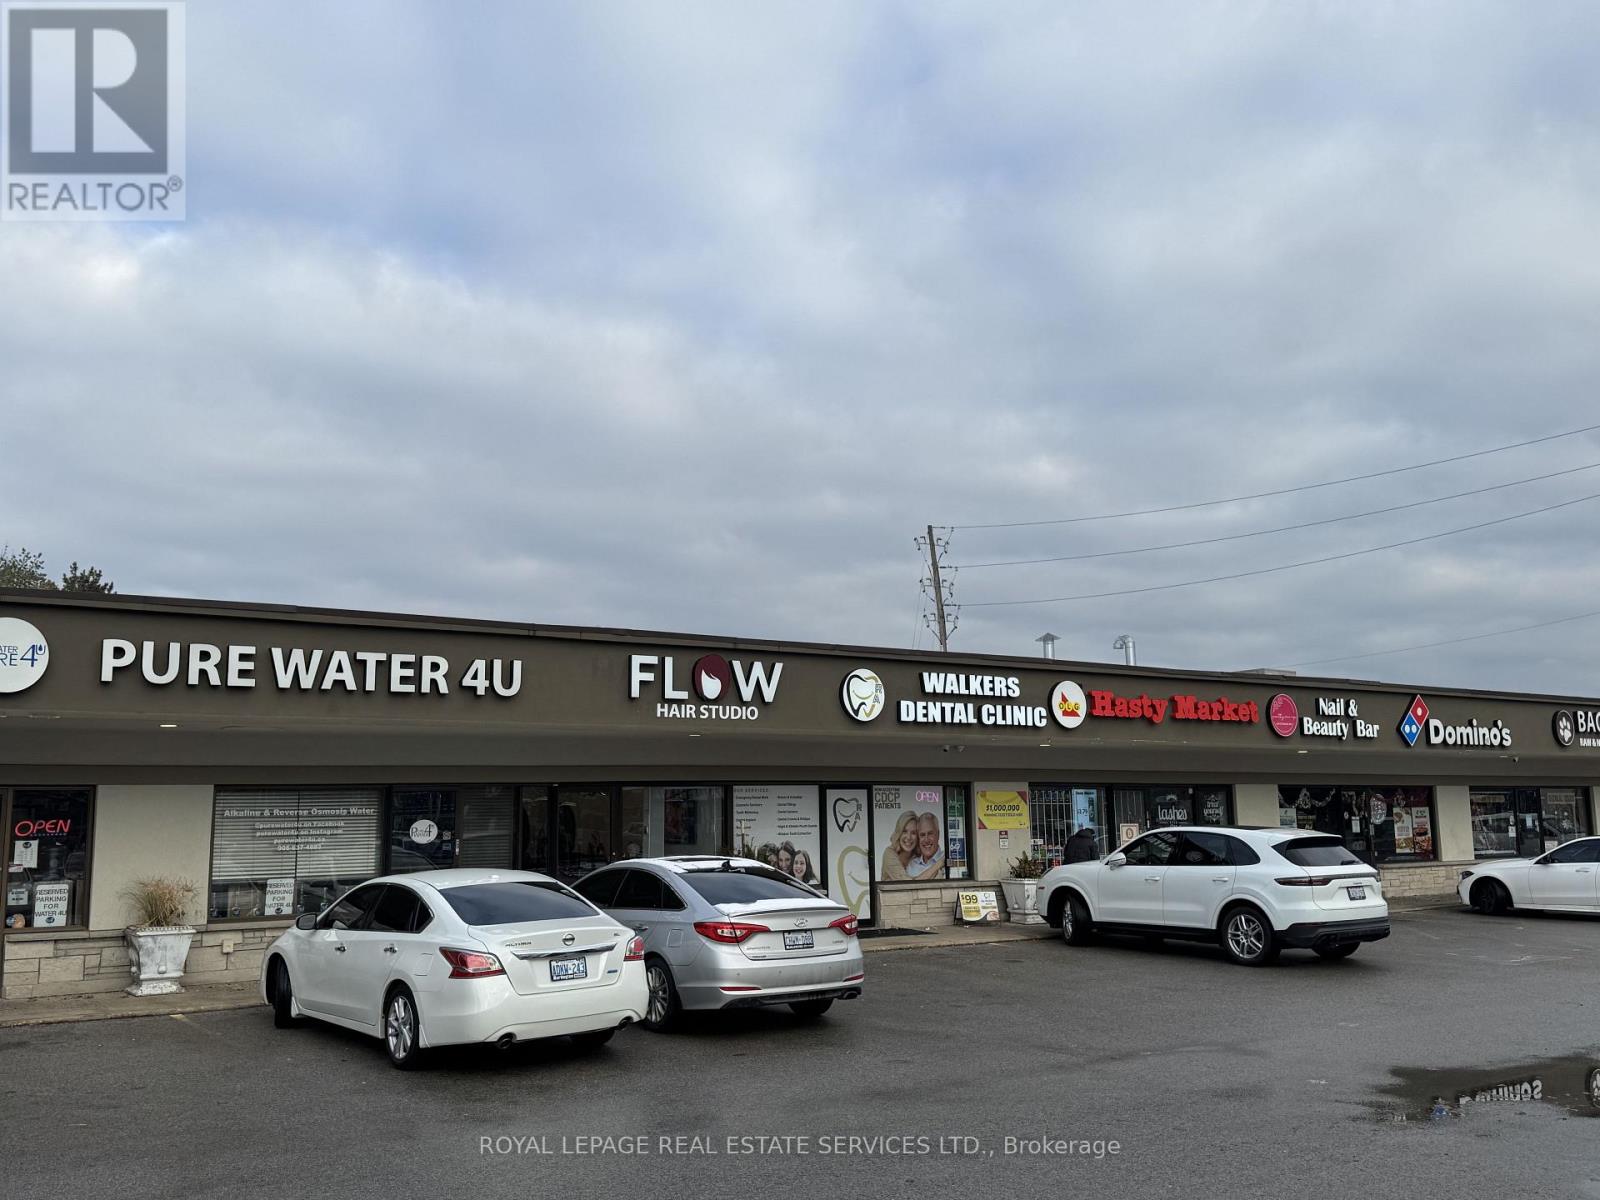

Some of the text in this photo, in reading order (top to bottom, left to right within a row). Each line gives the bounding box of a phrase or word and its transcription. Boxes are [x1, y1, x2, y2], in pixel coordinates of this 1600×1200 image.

[100, 638, 522, 697] PURE WATER 4U
[630, 654, 784, 702] FLOW
[921, 671, 1021, 698] WALKERS
[656, 703, 759, 720] HAIR STUDIO
[900, 700, 1048, 728] DENTAL CLINIC
[1090, 690, 1260, 724] Hasty Market
[1319, 697, 1358, 717] Nail &
[1303, 716, 1380, 740] Beauty Bar
[1429, 718, 1512, 747] Domino's
[875, 792, 901, 803] CDCP
[224, 809, 260, 817] Alkaline
[311, 808, 347, 816] Osmosis
[349, 807, 375, 816] Water
[1158, 804, 1188, 821] lashes
[15, 819, 71, 836] OPEN
[35, 888, 68, 896] RESERVED
